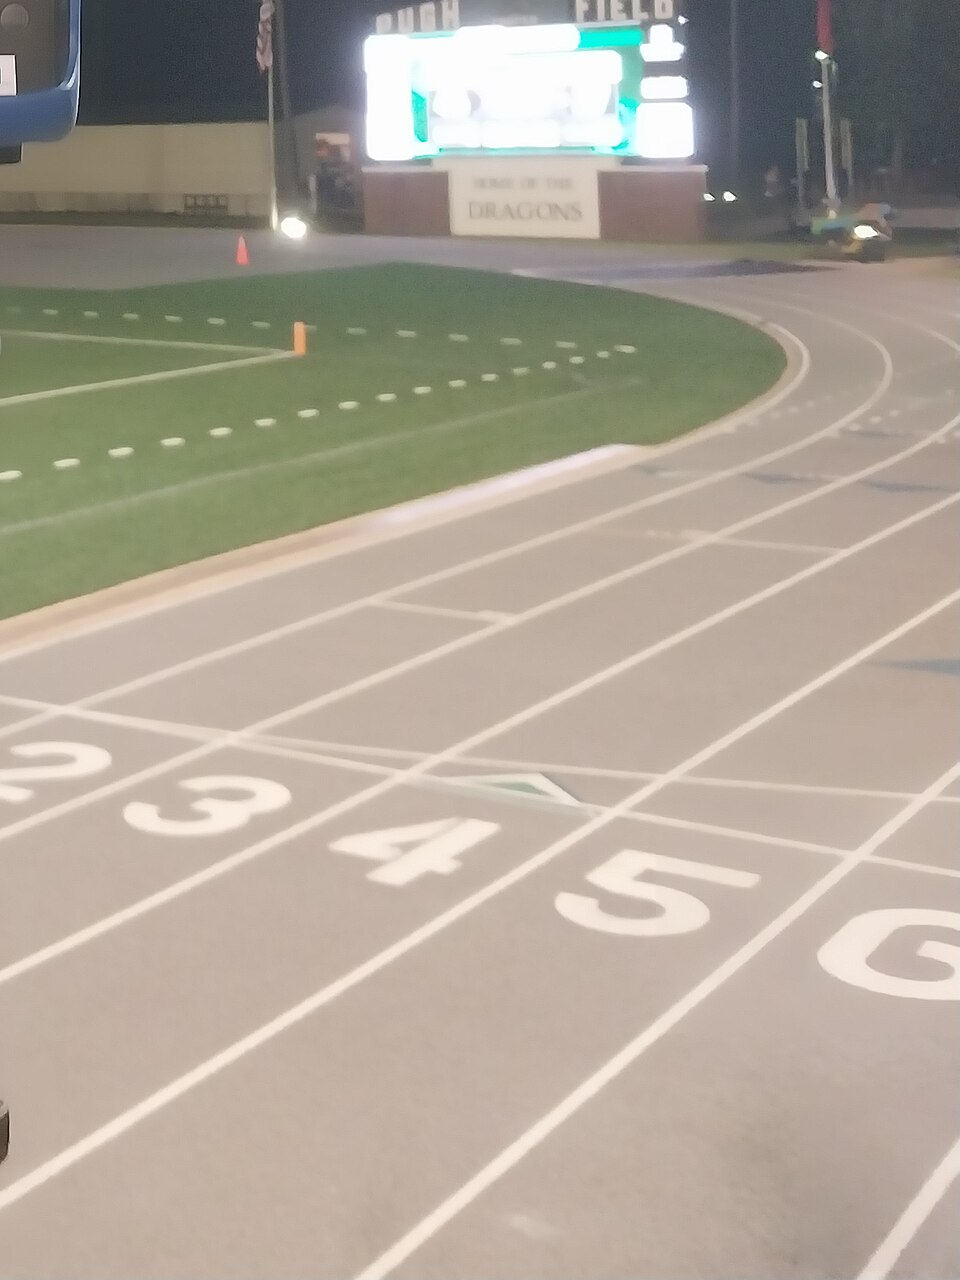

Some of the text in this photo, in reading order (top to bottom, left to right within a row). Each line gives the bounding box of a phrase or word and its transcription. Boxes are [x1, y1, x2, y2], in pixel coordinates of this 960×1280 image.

[468, 200, 584, 221] DRAGONS
[123, 775, 292, 837] 3
[328, 817, 502, 888] 4
[554, 849, 762, 937] 5
